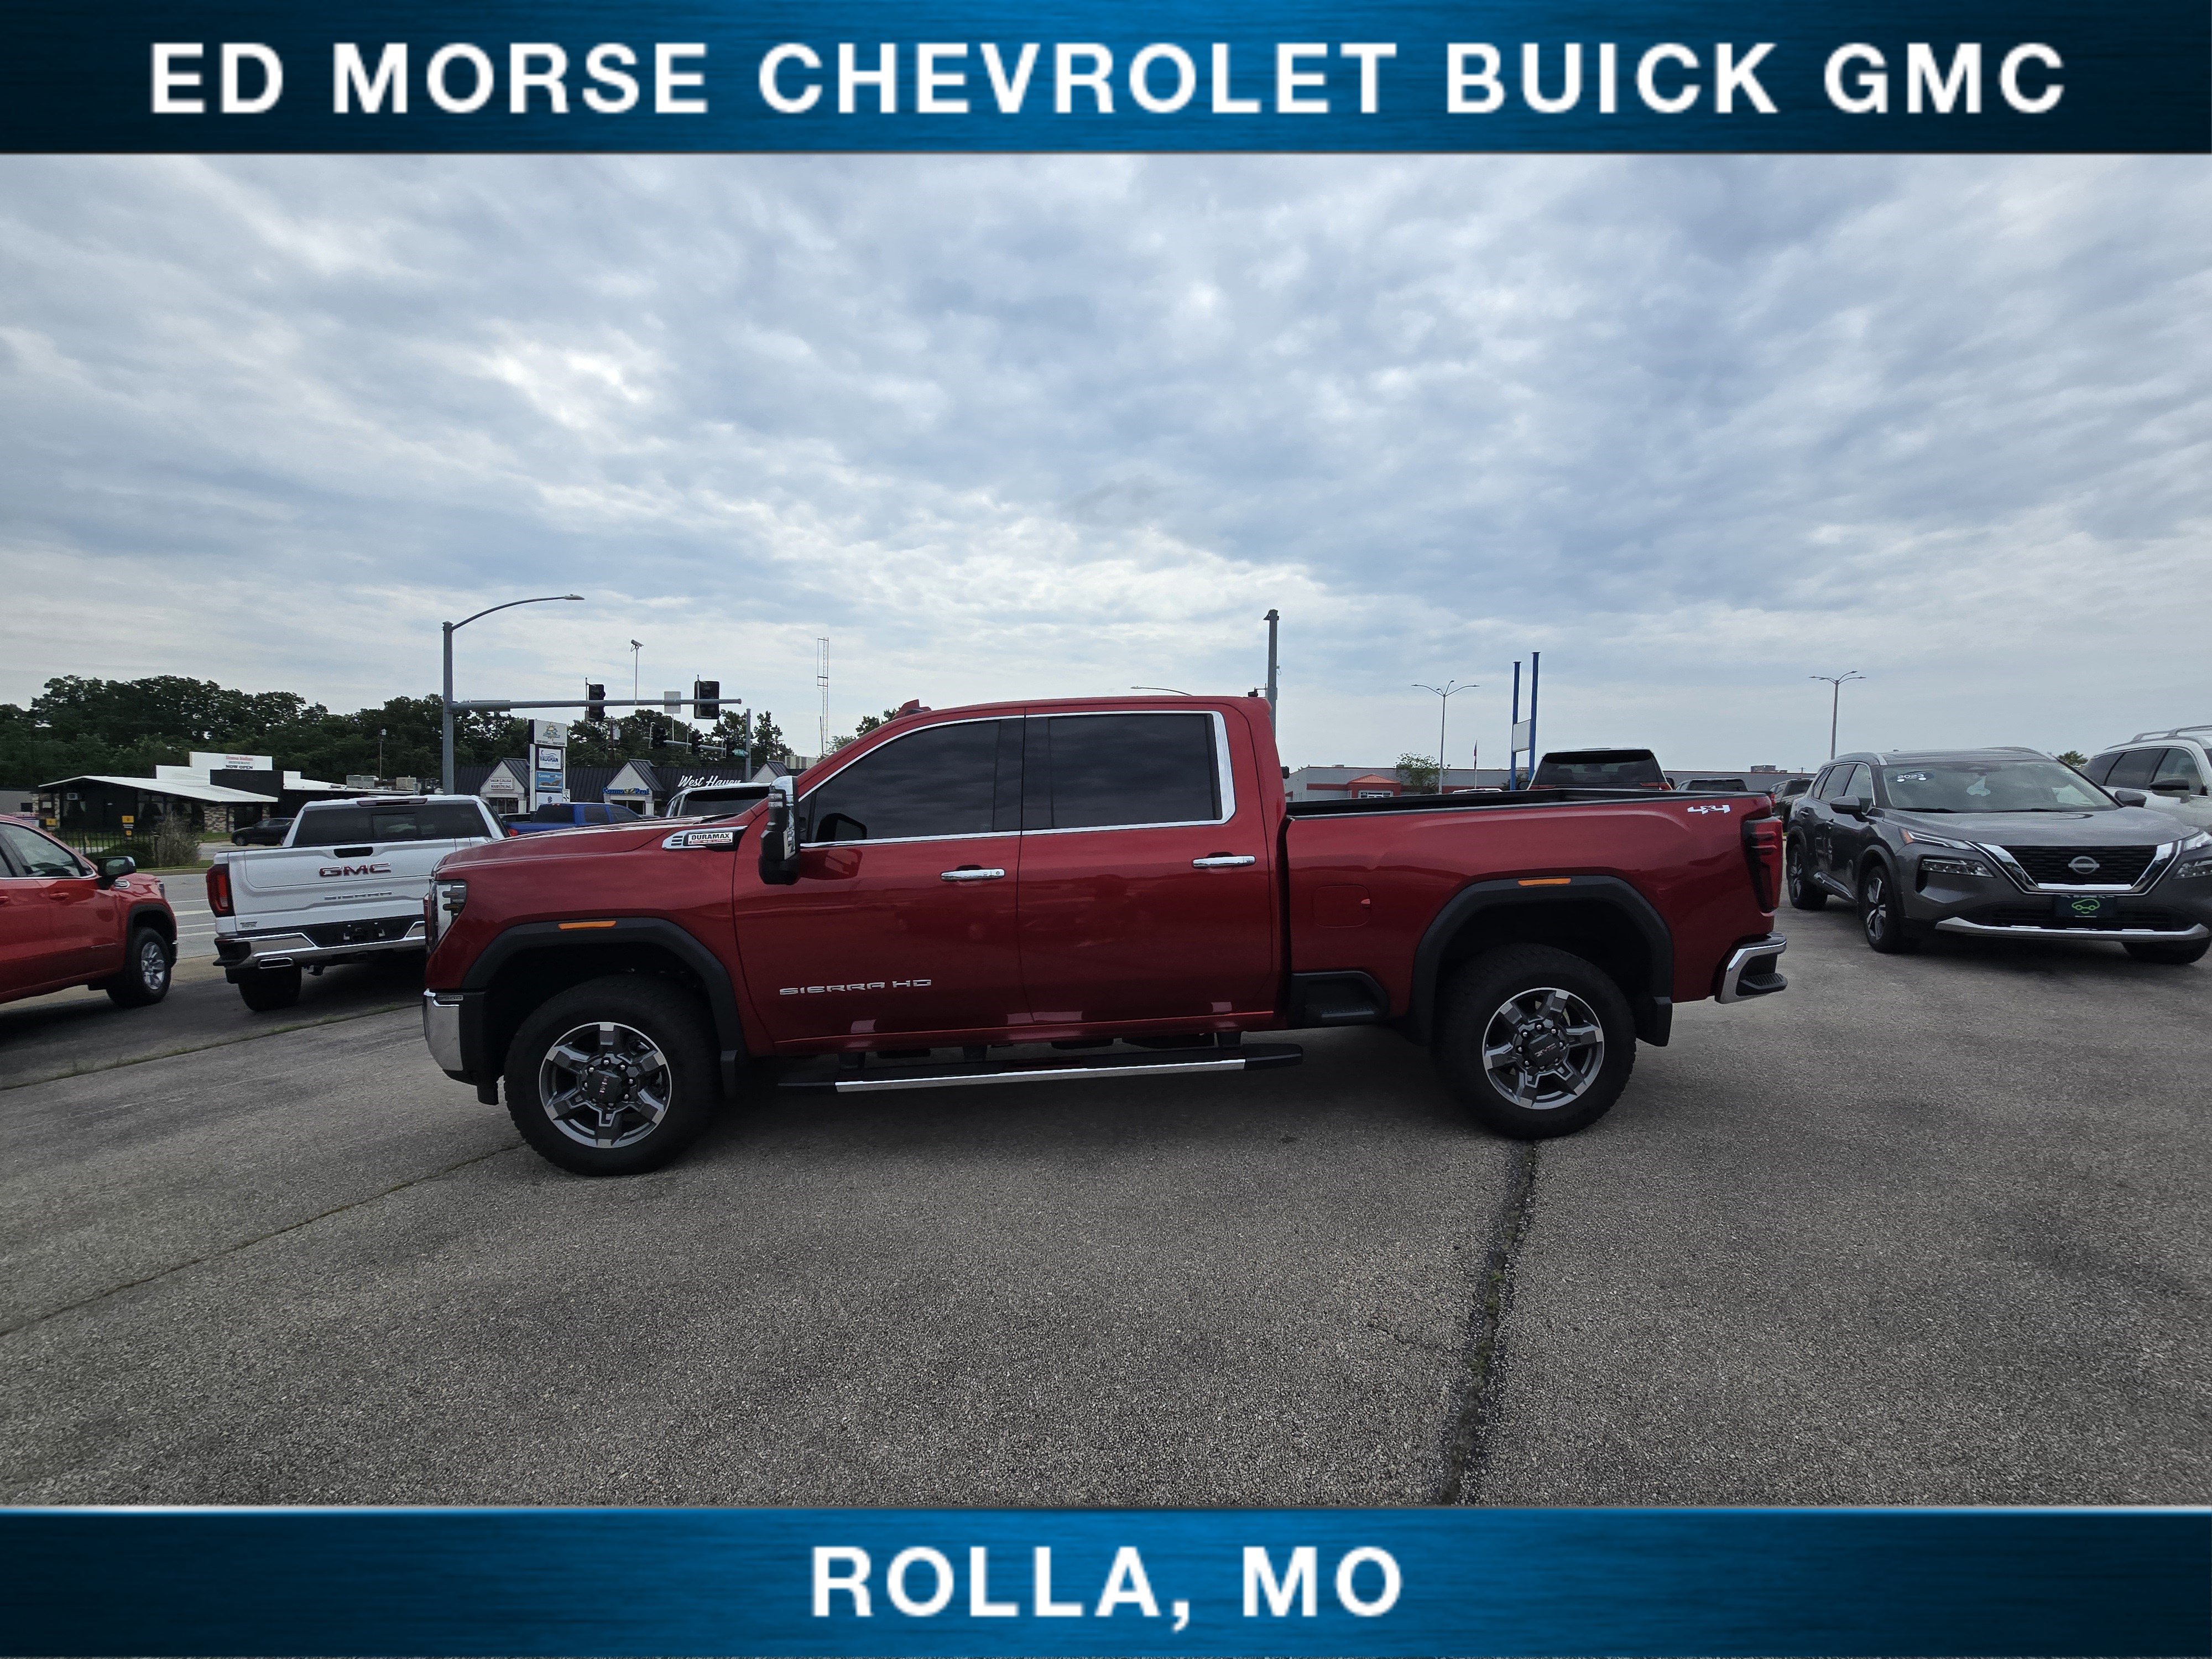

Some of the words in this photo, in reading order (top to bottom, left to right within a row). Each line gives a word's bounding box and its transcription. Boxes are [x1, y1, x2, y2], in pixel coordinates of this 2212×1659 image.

[677, 775, 705, 787] West
[319, 862, 392, 877] GMC
[779, 982, 885, 995] SIERRA
[892, 979, 932, 988] HD
